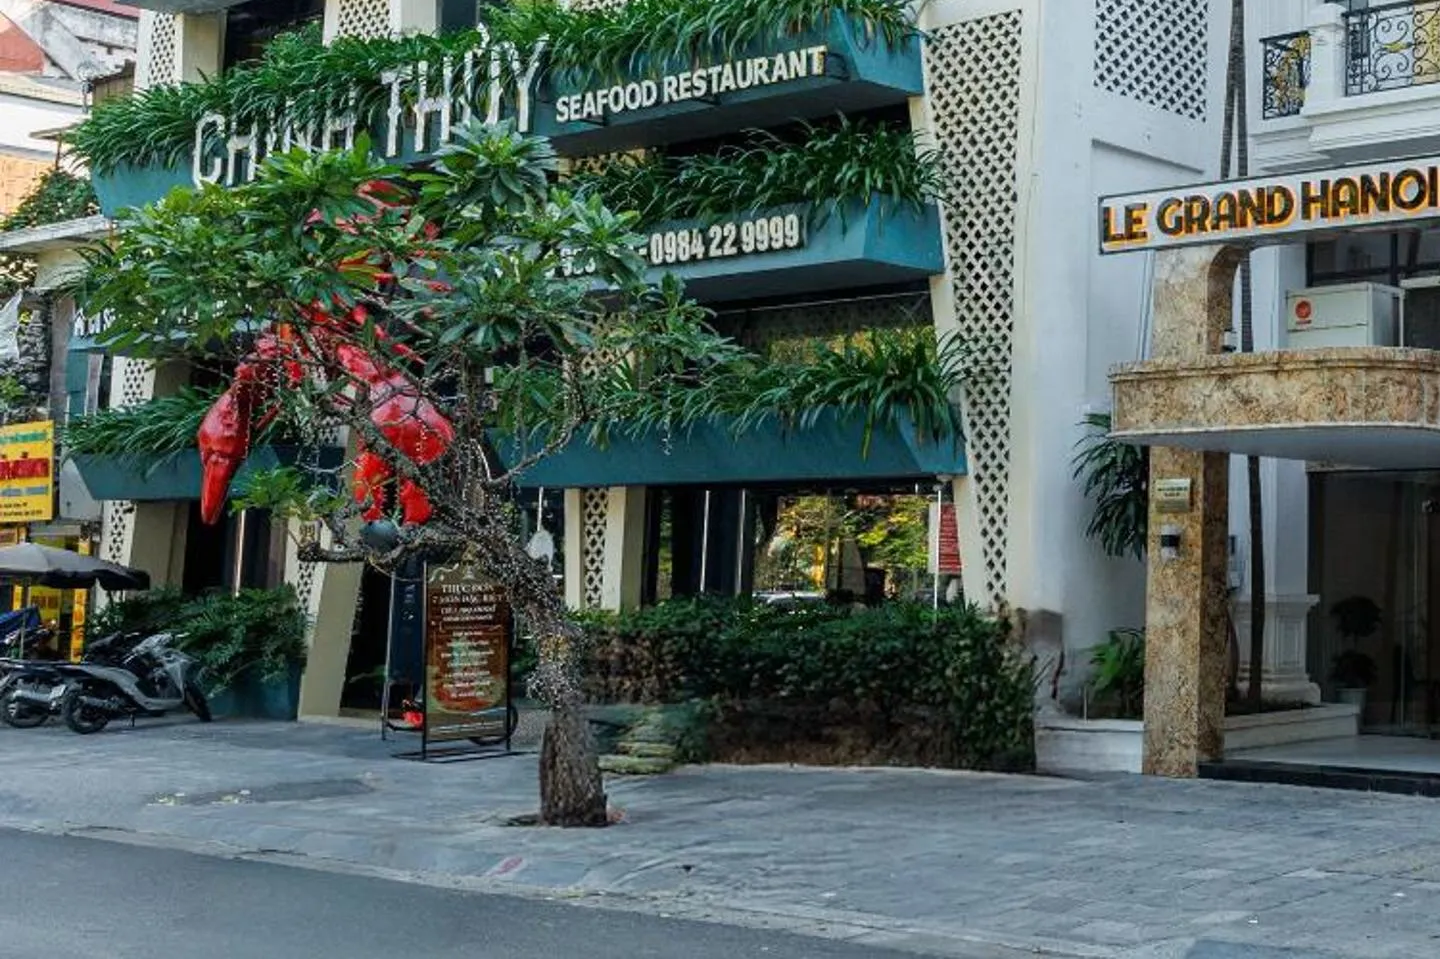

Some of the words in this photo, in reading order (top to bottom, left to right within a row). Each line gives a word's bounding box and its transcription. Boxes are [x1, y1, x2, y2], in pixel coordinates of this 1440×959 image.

[555, 78, 657, 122] SEAFOOD
[662, 45, 826, 104] RESTAURANT
[651, 228, 704, 265] 0984
[708, 221, 738, 257] 22
[741, 213, 800, 253] 9999
[1102, 203, 1150, 246] LE
[1156, 185, 1297, 239] GRAND
[1301, 167, 1439, 222] HANOI
